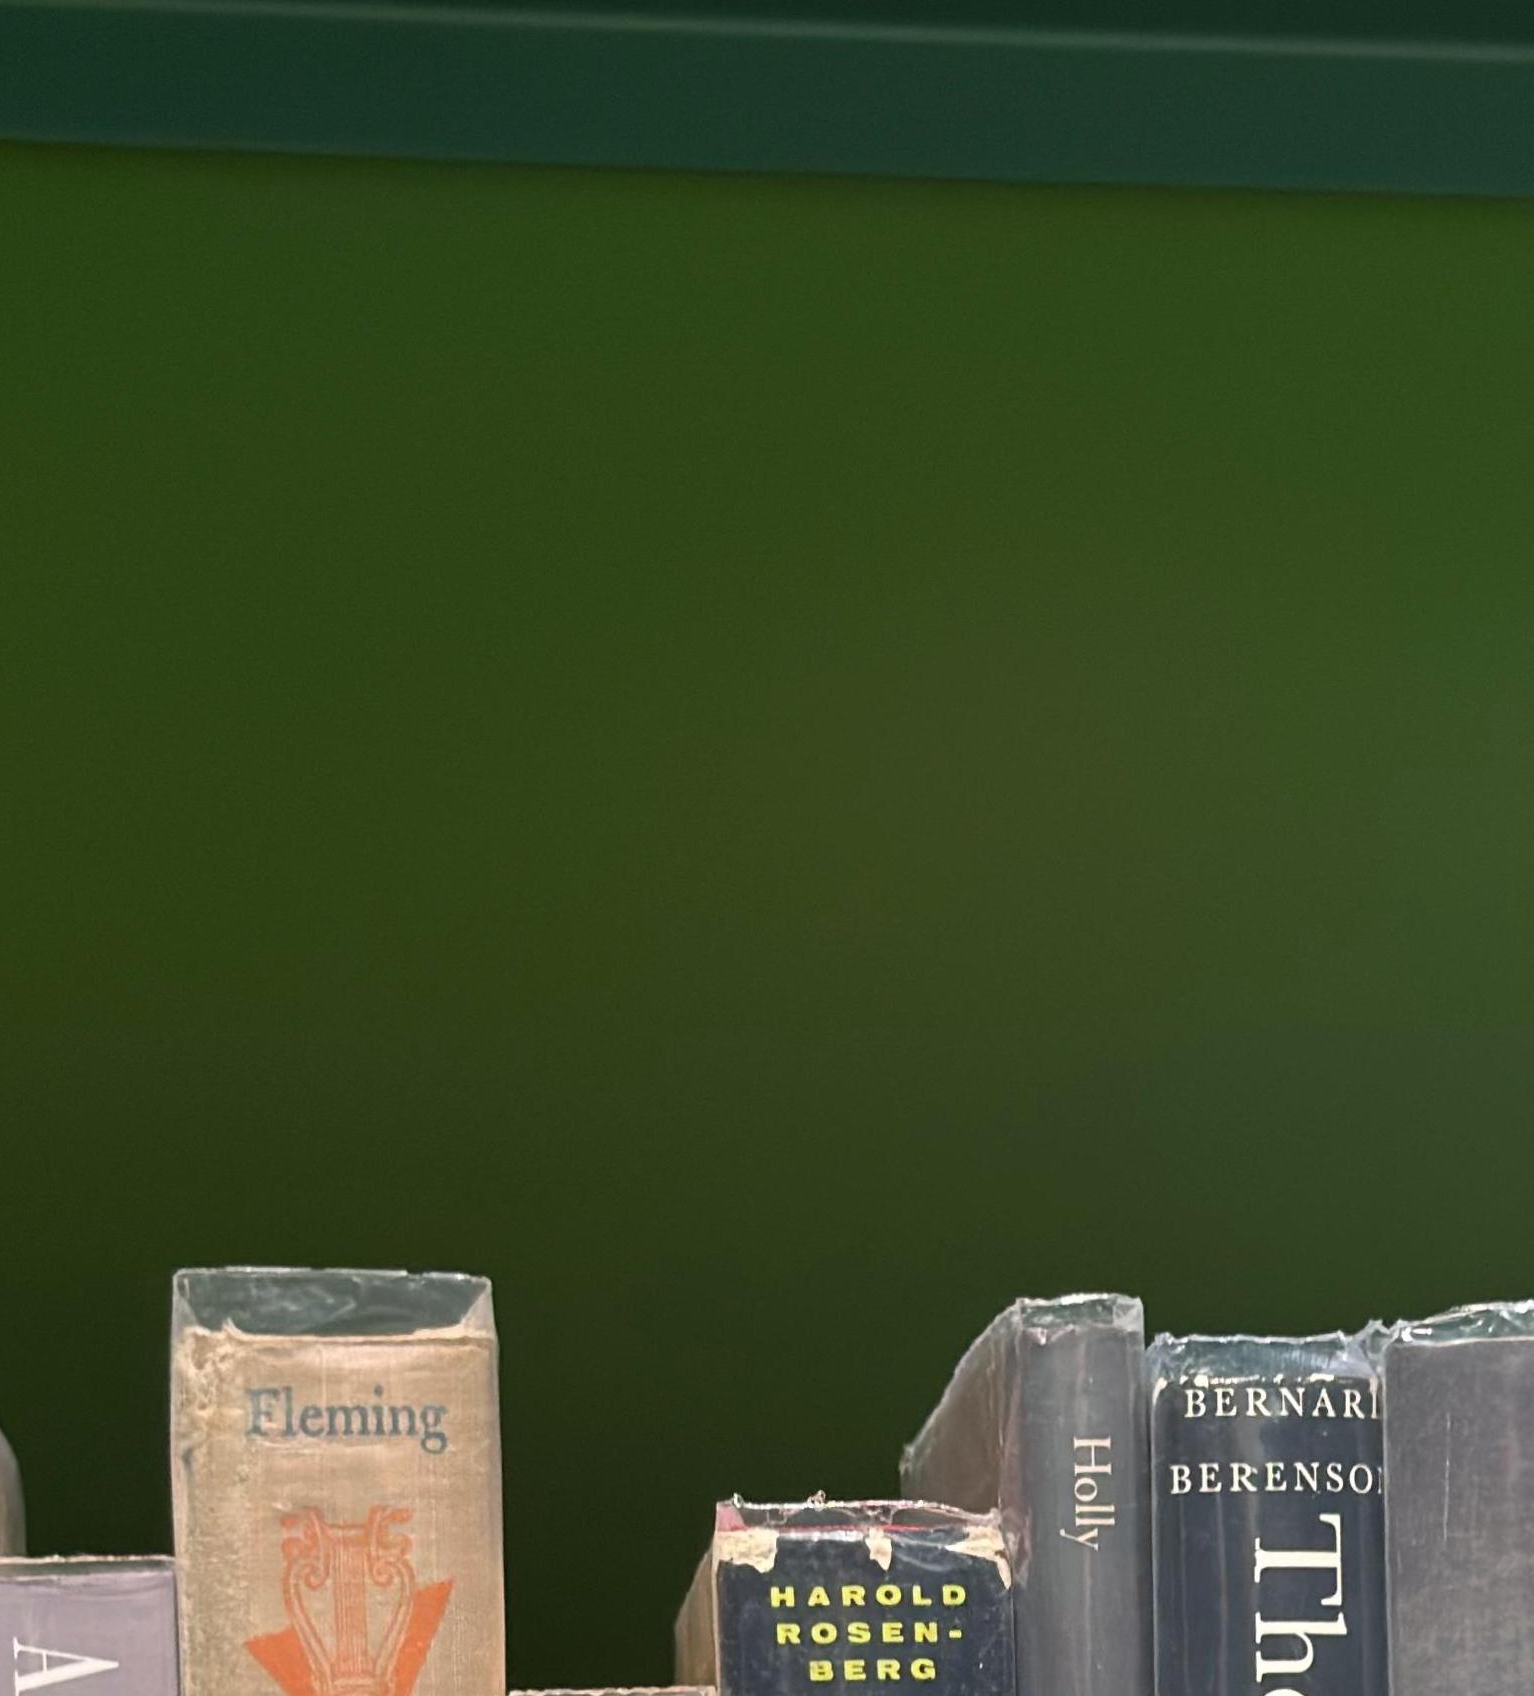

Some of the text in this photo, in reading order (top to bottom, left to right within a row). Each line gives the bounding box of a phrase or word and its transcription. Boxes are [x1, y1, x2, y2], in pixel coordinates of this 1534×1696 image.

[244, 1385, 448, 1454] Fleming
[1060, 1435, 1115, 1552] Holly
[770, 1584, 969, 1609] HAROLD
[775, 1622, 963, 1645] ROSEN-
[809, 1659, 938, 1683] BERG
